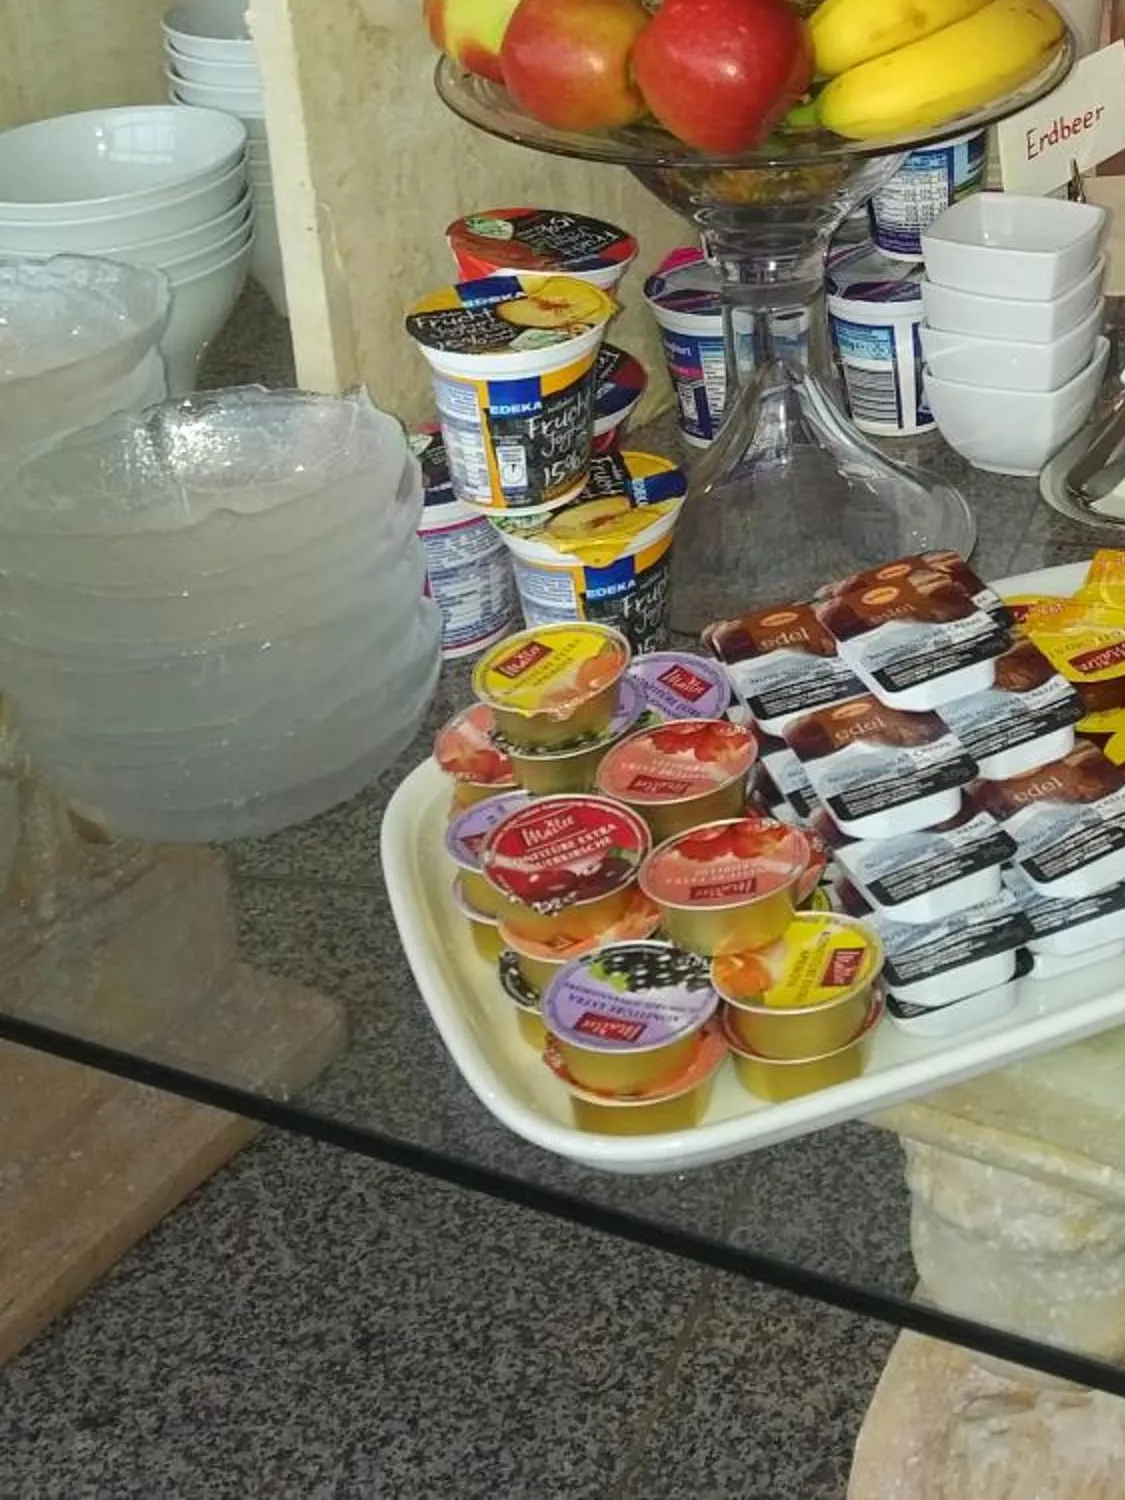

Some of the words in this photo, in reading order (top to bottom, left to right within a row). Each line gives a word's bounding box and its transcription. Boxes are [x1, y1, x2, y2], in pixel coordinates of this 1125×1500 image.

[1025, 104, 1105, 160] Erdbeer
[489, 401, 542, 414] EDEKA
[586, 579, 636, 598] EDEKA
[520, 814, 574, 846] Maître
